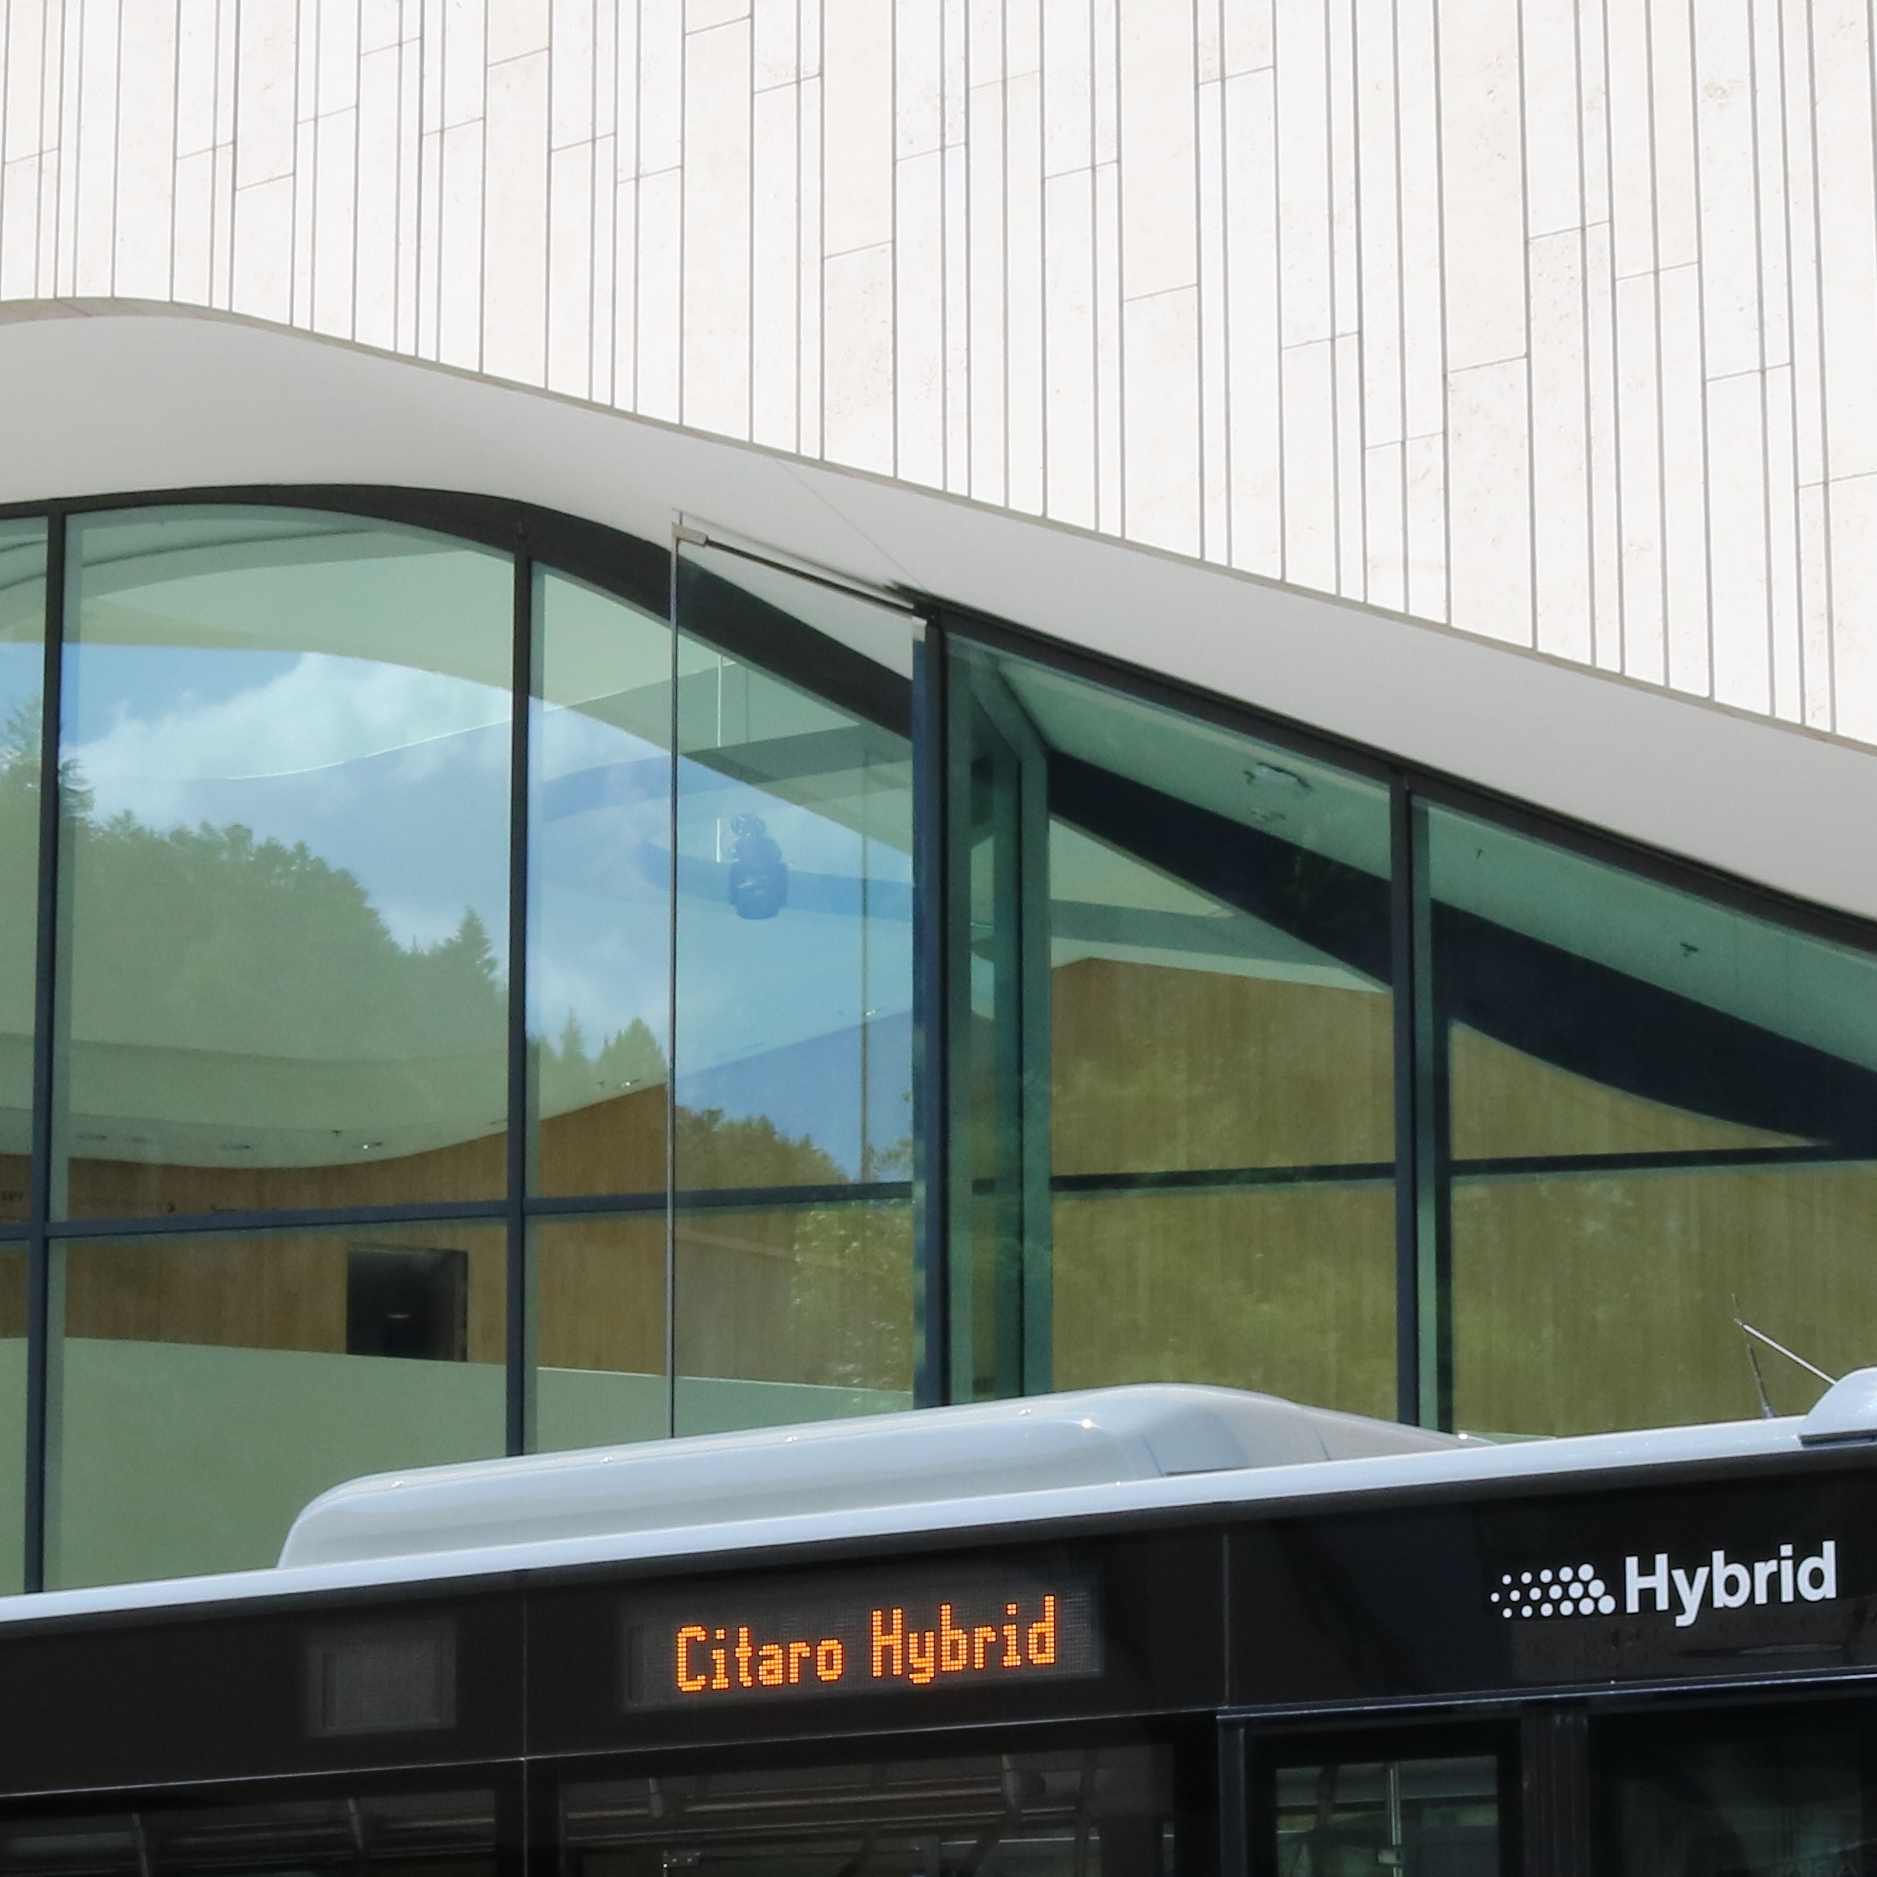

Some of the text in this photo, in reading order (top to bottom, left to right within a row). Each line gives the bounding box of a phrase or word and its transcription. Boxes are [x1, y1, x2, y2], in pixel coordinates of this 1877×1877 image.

[1624, 1541, 1839, 1627] Hybrid
[675, 1594, 1058, 1693] Citaro Hybrid
